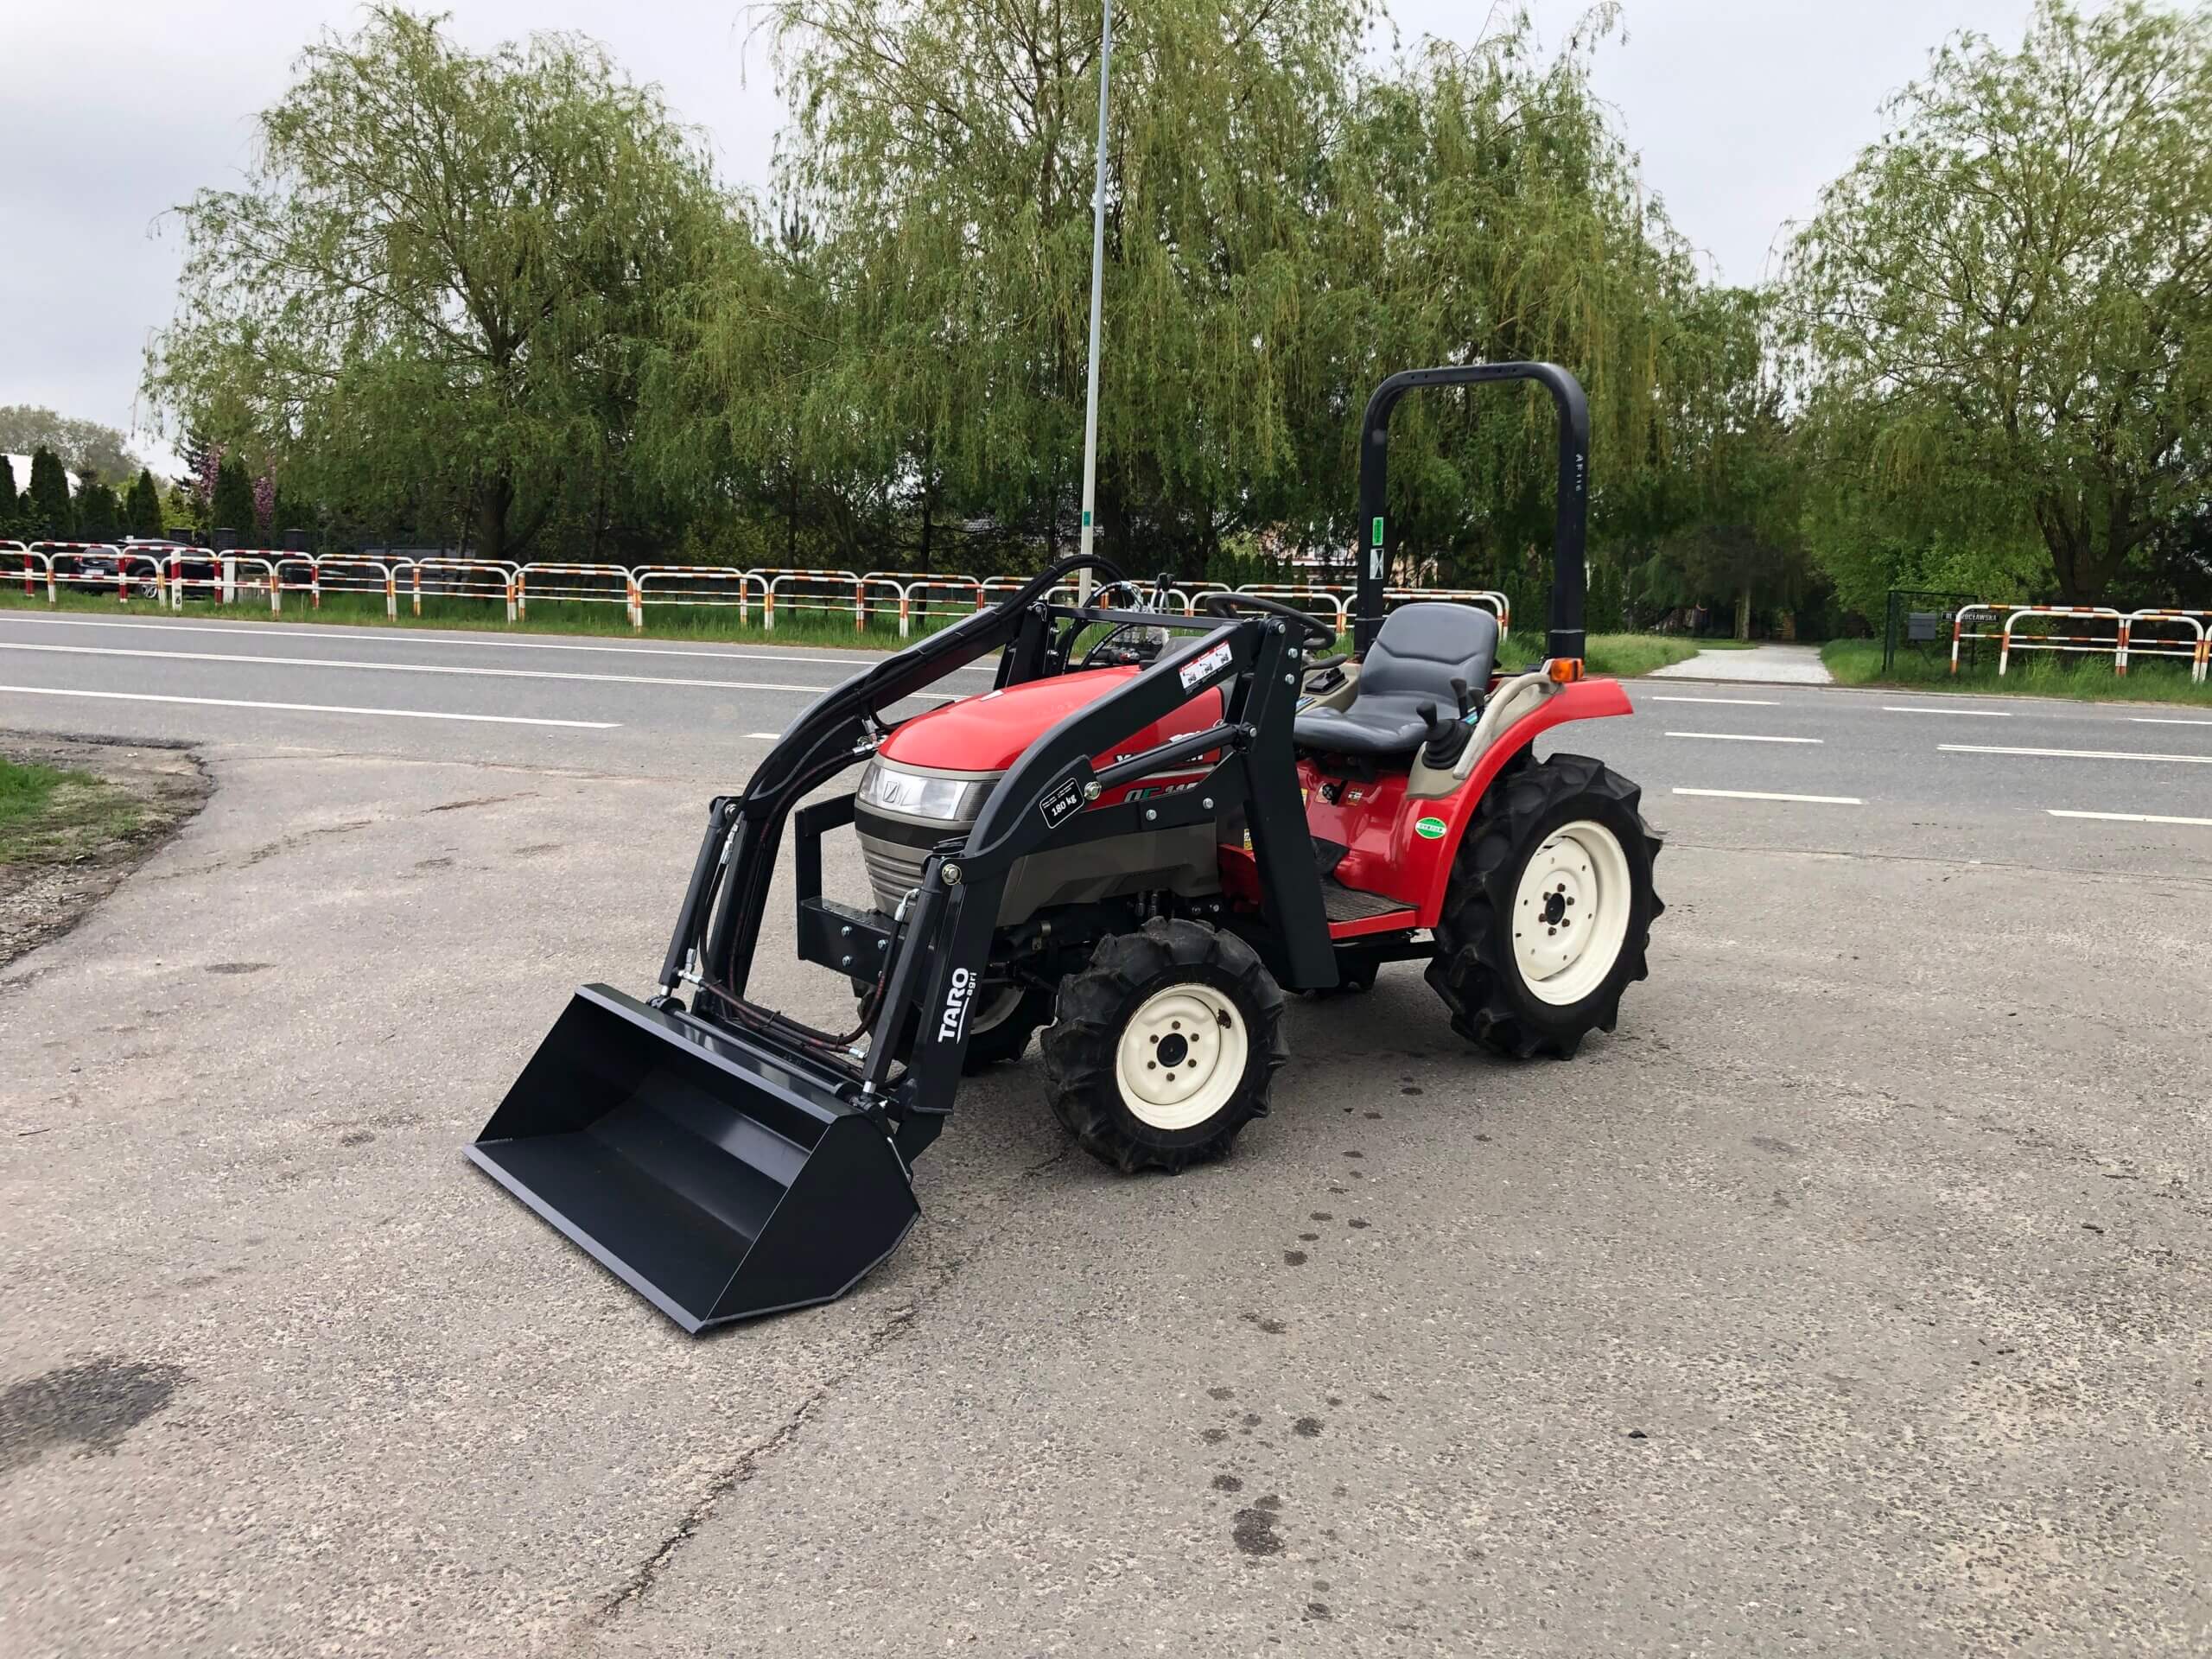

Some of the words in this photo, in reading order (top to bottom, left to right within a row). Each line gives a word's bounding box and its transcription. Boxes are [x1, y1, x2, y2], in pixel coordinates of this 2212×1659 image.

[1052, 801, 1066, 816] 180
[1065, 794, 1077, 805] kg
[966, 972, 977, 996] agri
[938, 968, 969, 1043] TARO
